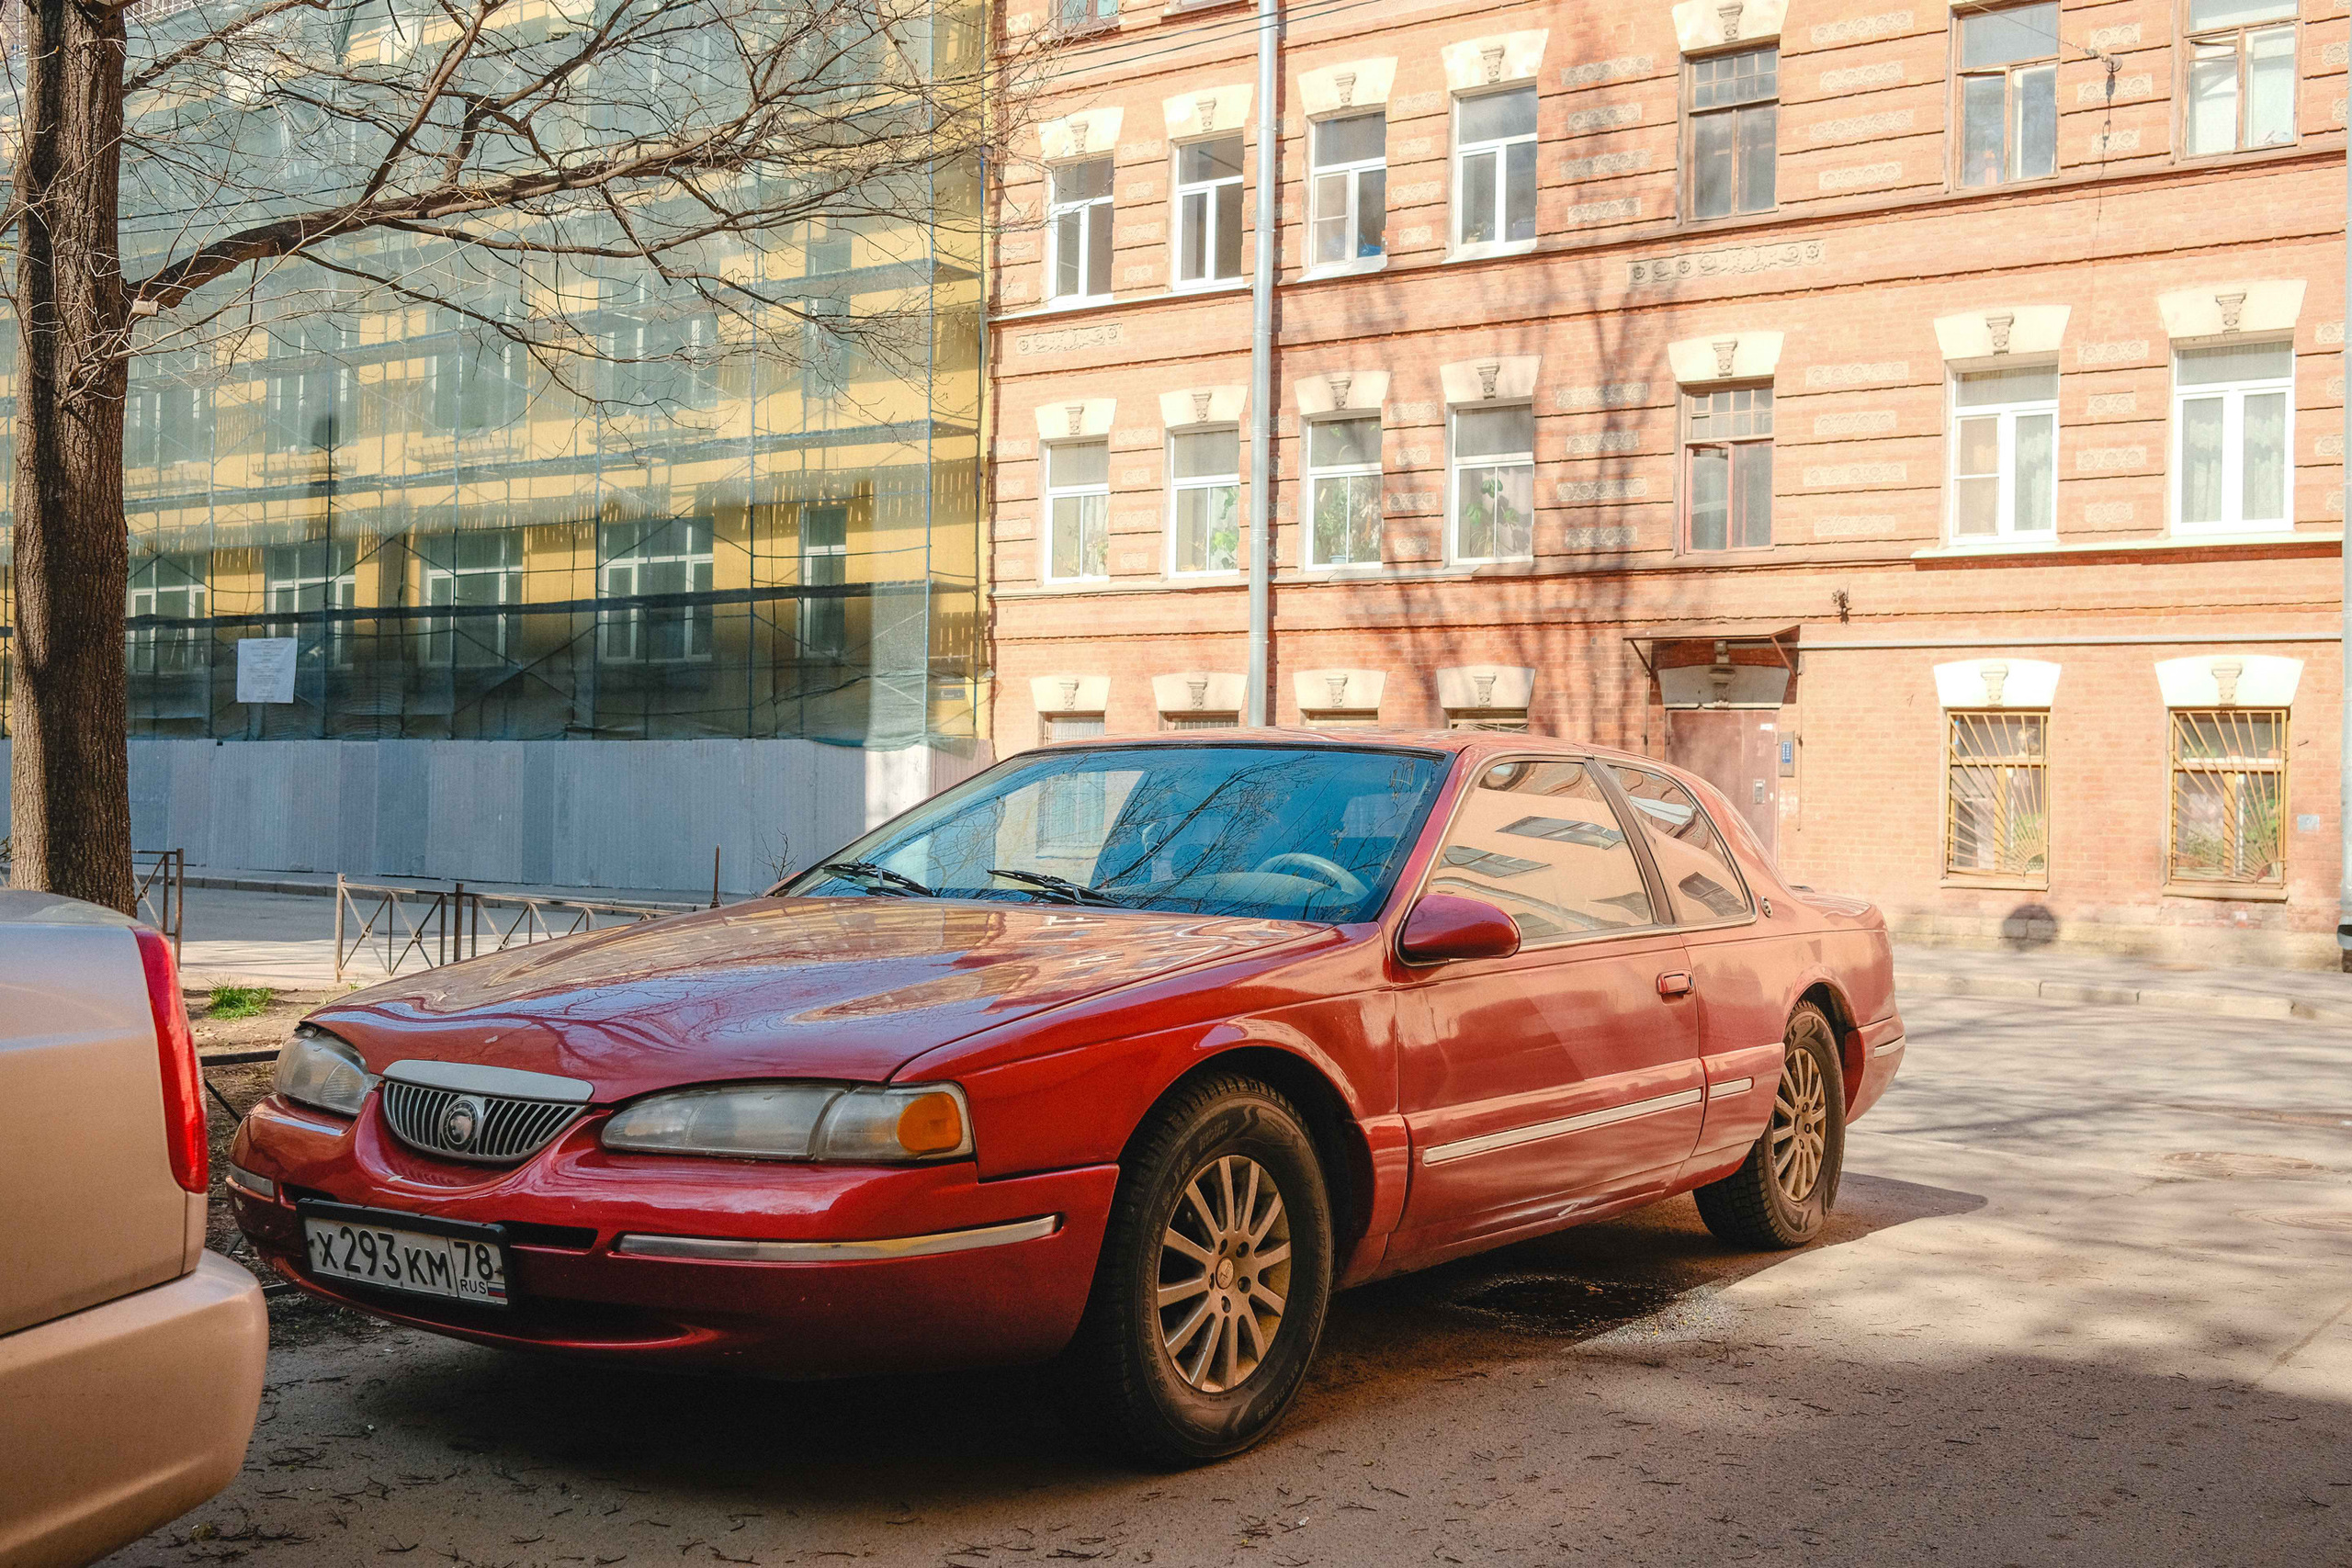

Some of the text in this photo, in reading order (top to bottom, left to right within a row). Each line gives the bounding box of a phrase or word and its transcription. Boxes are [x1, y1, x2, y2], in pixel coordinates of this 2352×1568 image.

[454, 1241, 493, 1280] 78
[460, 1280, 487, 1294] RUS
[1257, 1359, 1300, 1421] STUDLESS
